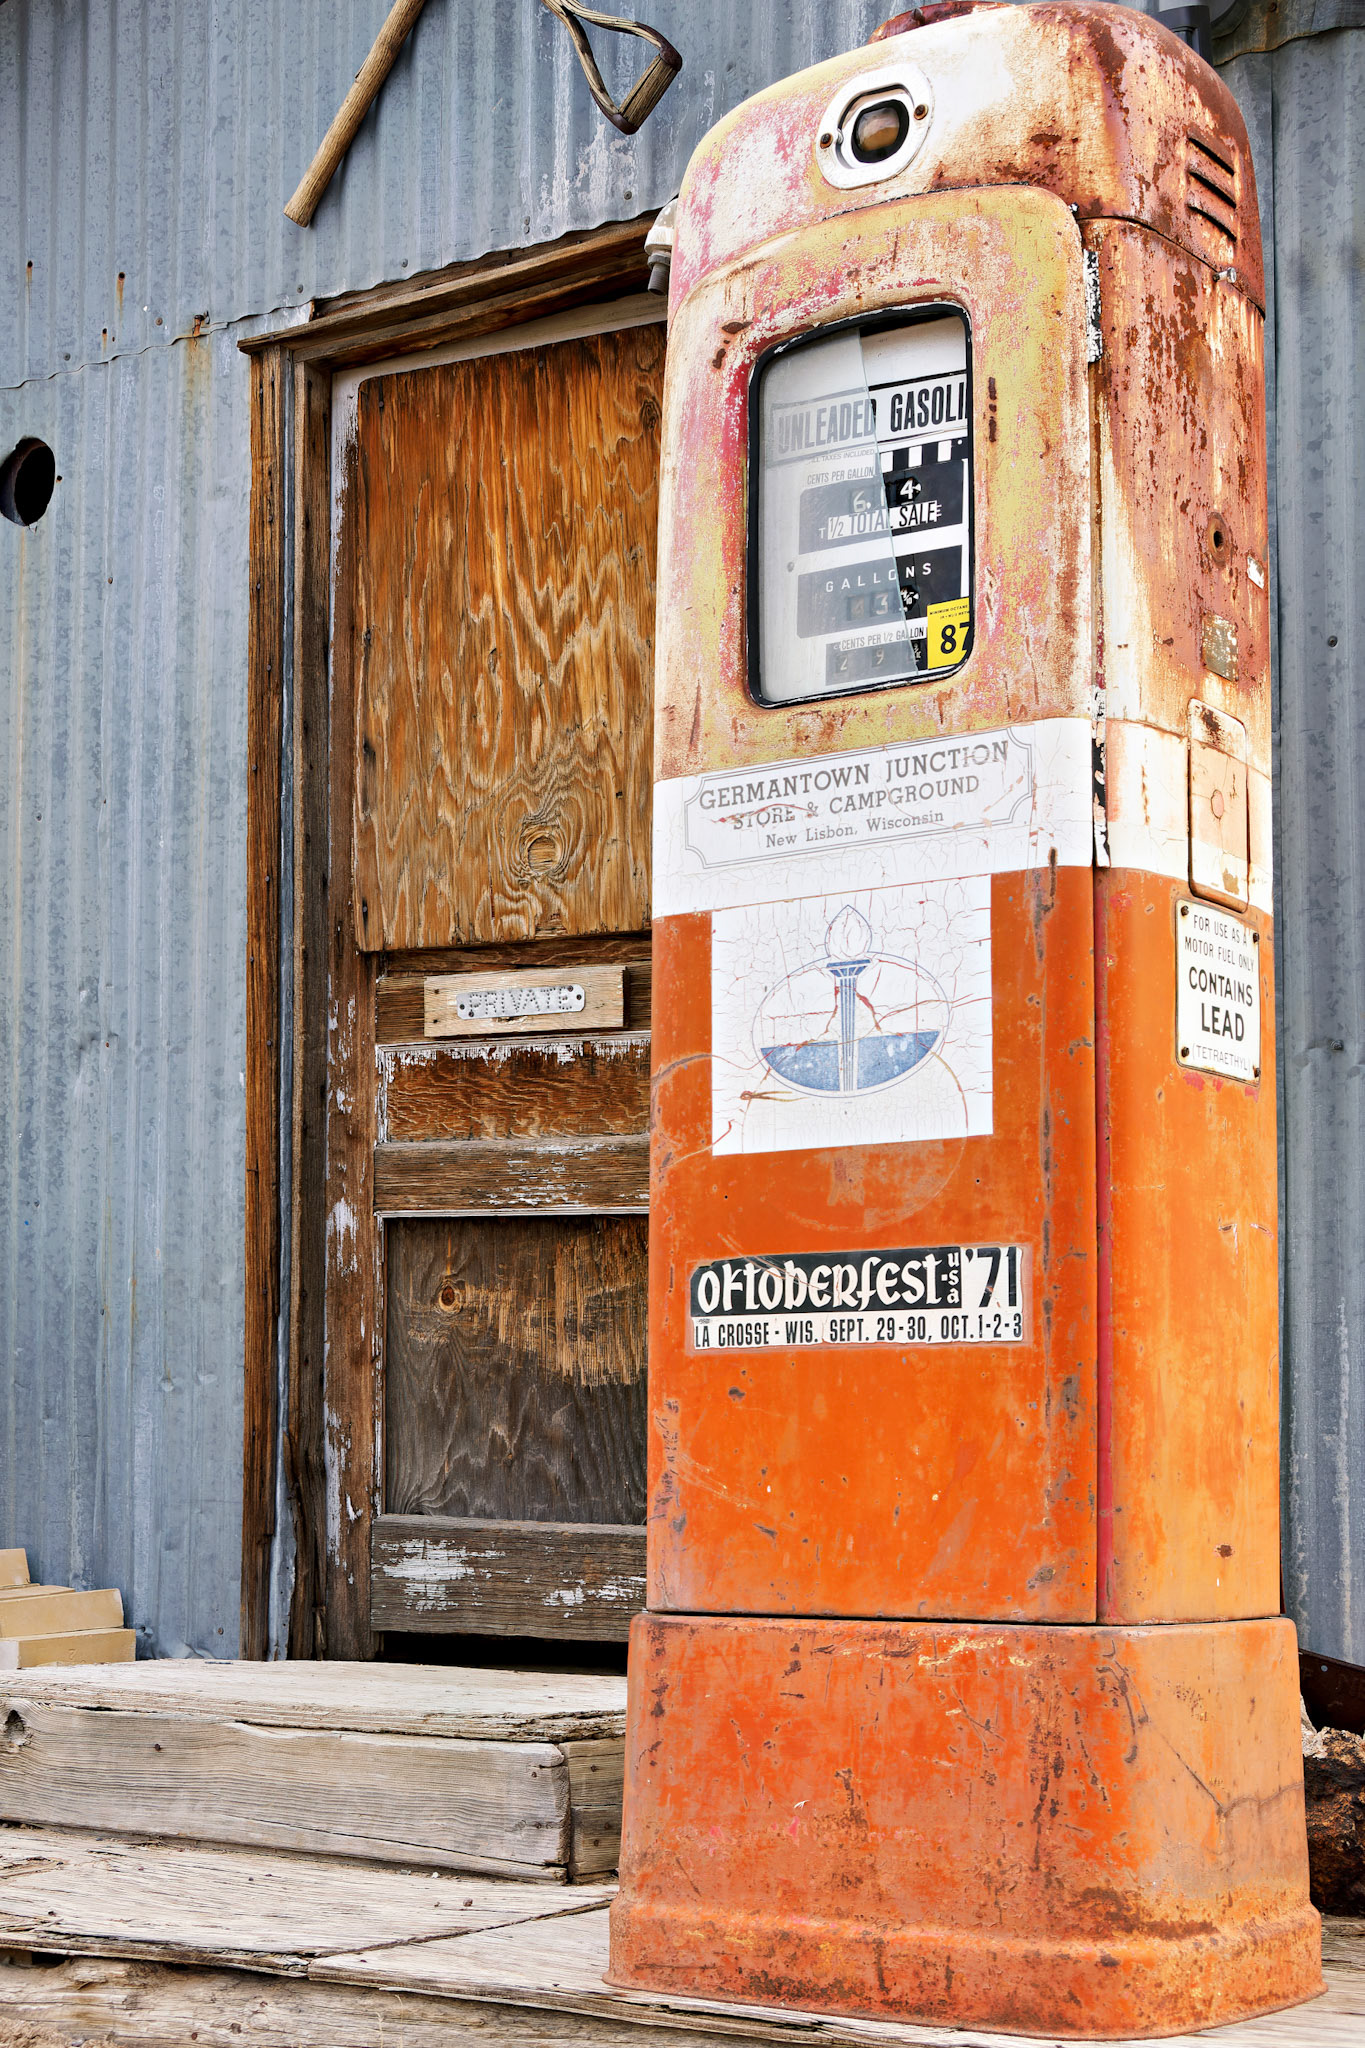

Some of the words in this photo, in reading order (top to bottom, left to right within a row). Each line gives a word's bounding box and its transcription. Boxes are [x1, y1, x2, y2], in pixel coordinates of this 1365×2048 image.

[778, 398, 877, 454] UNLEADED
[821, 453, 842, 462] TAXES
[843, 448, 876, 459] INCLUDED
[807, 472, 830, 486] CENTS
[831, 470, 845, 482] PER
[847, 466, 875, 480] GALLON
[829, 516, 844, 539] 1/2
[849, 508, 894, 535] TOTAL
[898, 501, 936, 527] SALE
[825, 562, 932, 593] GALLONS
[841, 636, 865, 650] CENTS
[867, 633, 882, 646] PER
[940, 621, 971, 655] 87
[699, 762, 871, 811] GERMANTOWN
[886, 740, 1009, 783] JUNCTION
[733, 803, 796, 831] STORE
[806, 801, 819, 819] &
[828, 774, 980, 815] CAMPGROUND
[766, 832, 798, 849] New
[805, 821, 859, 844] Lisbon,
[866, 810, 945, 833] Wisconsin
[1193, 914, 1211, 934] FOR
[1214, 921, 1229, 939] USE
[1231, 927, 1241, 944] AS
[1184, 936, 1214, 958] MOTOR
[1218, 946, 1236, 965] FUEL
[1238, 953, 1255, 973] ONLY
[469, 985, 574, 1016] PRIVATE
[1188, 966, 1253, 1008] CONTAINS
[1201, 1002, 1245, 1042] LEAD
[1192, 1042, 1251, 1074] (TETRAETHYL)
[965, 1246, 1017, 1308] '71
[695, 1325, 710, 1348] LA
[718, 1322, 770, 1347] CROSSE
[785, 1319, 819, 1344] WIS.
[829, 1318, 870, 1343] SEPT.
[941, 1314, 974, 1340] OCT.
